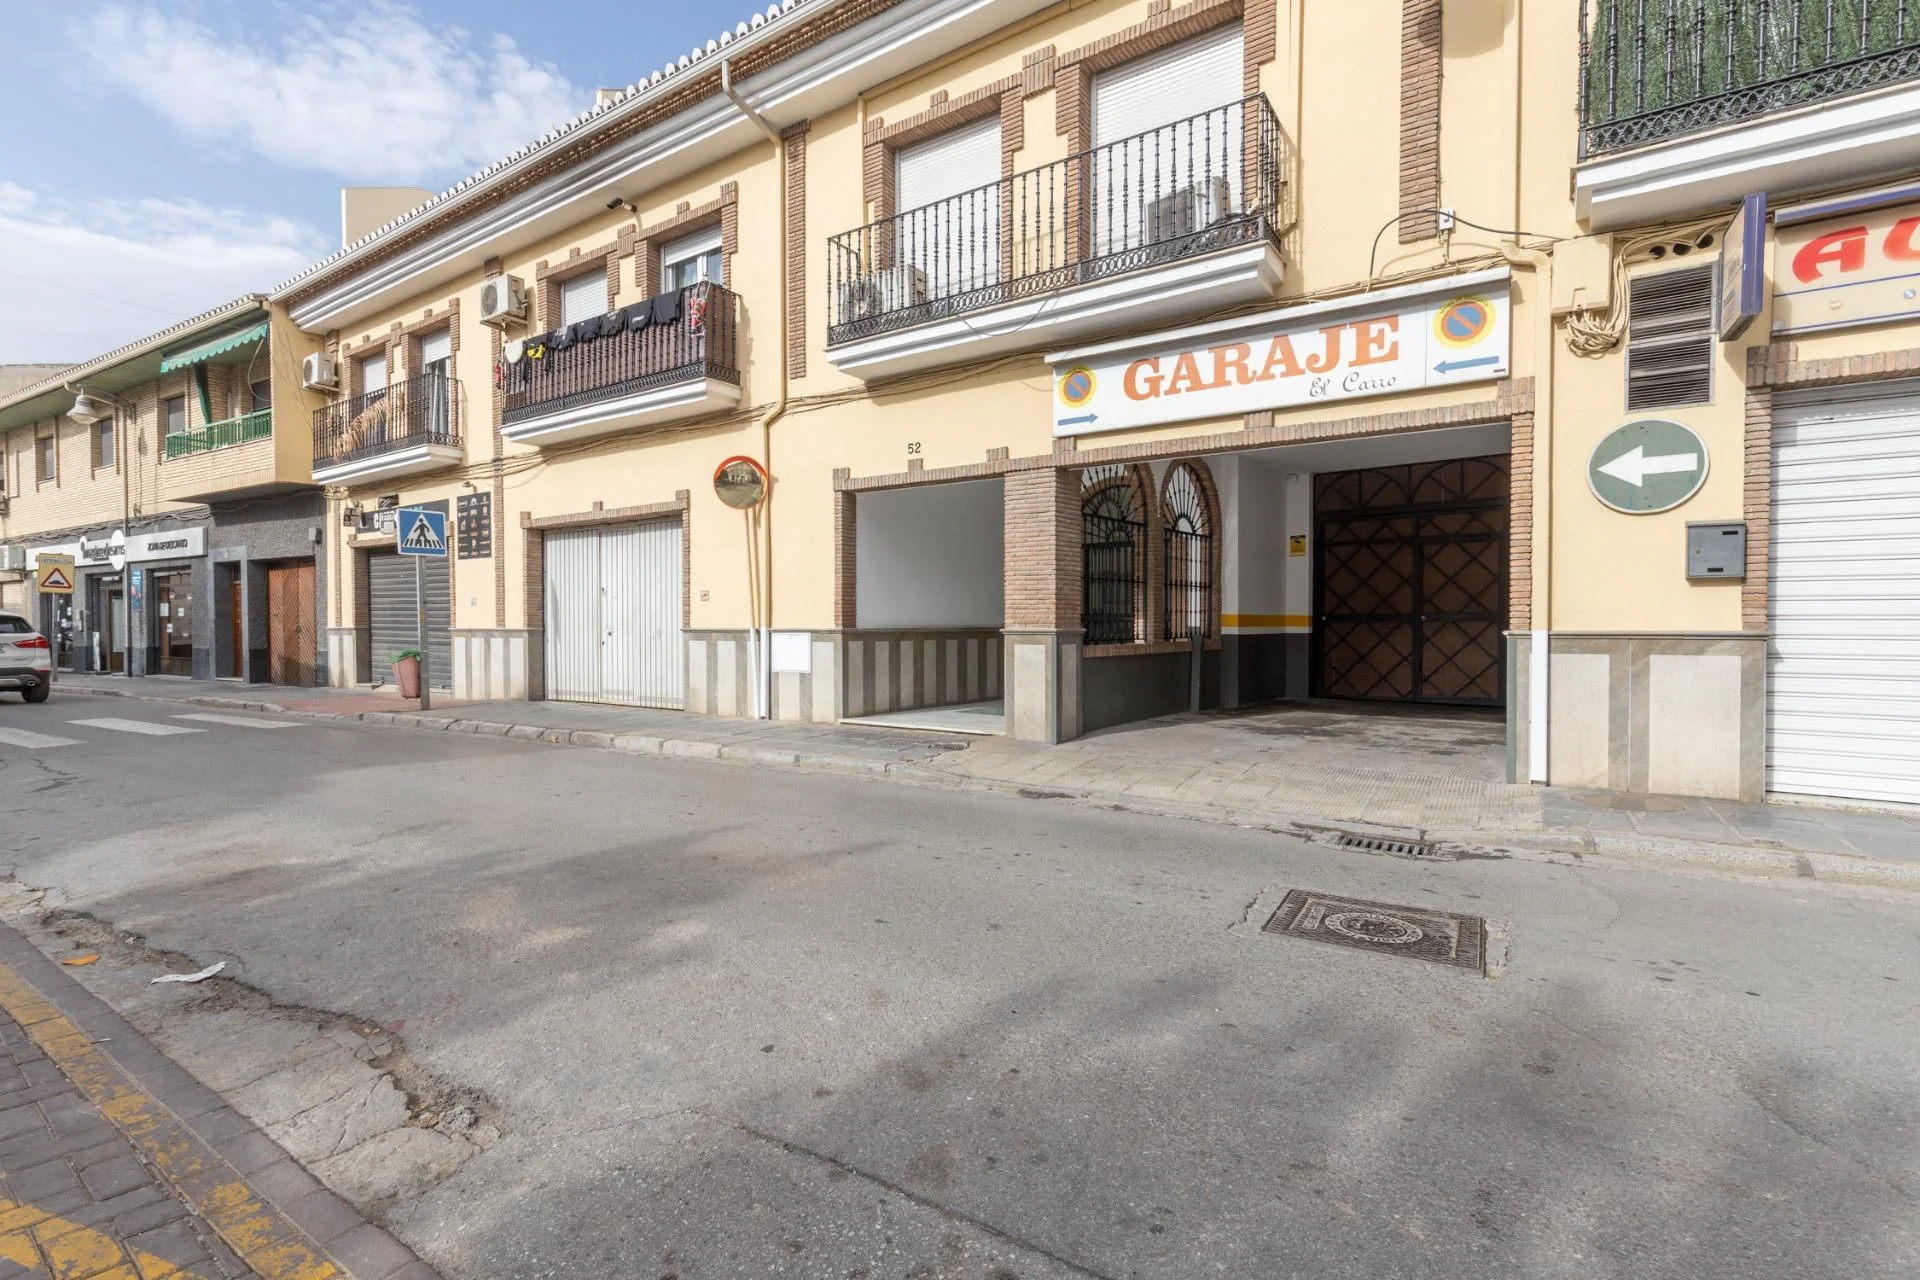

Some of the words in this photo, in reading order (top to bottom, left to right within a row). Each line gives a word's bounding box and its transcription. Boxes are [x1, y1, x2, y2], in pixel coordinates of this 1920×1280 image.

[1123, 314, 1399, 401] GARAJE
[1309, 377, 1331, 398] El
[1342, 371, 1397, 392] Carro
[907, 441, 922, 455] 52
